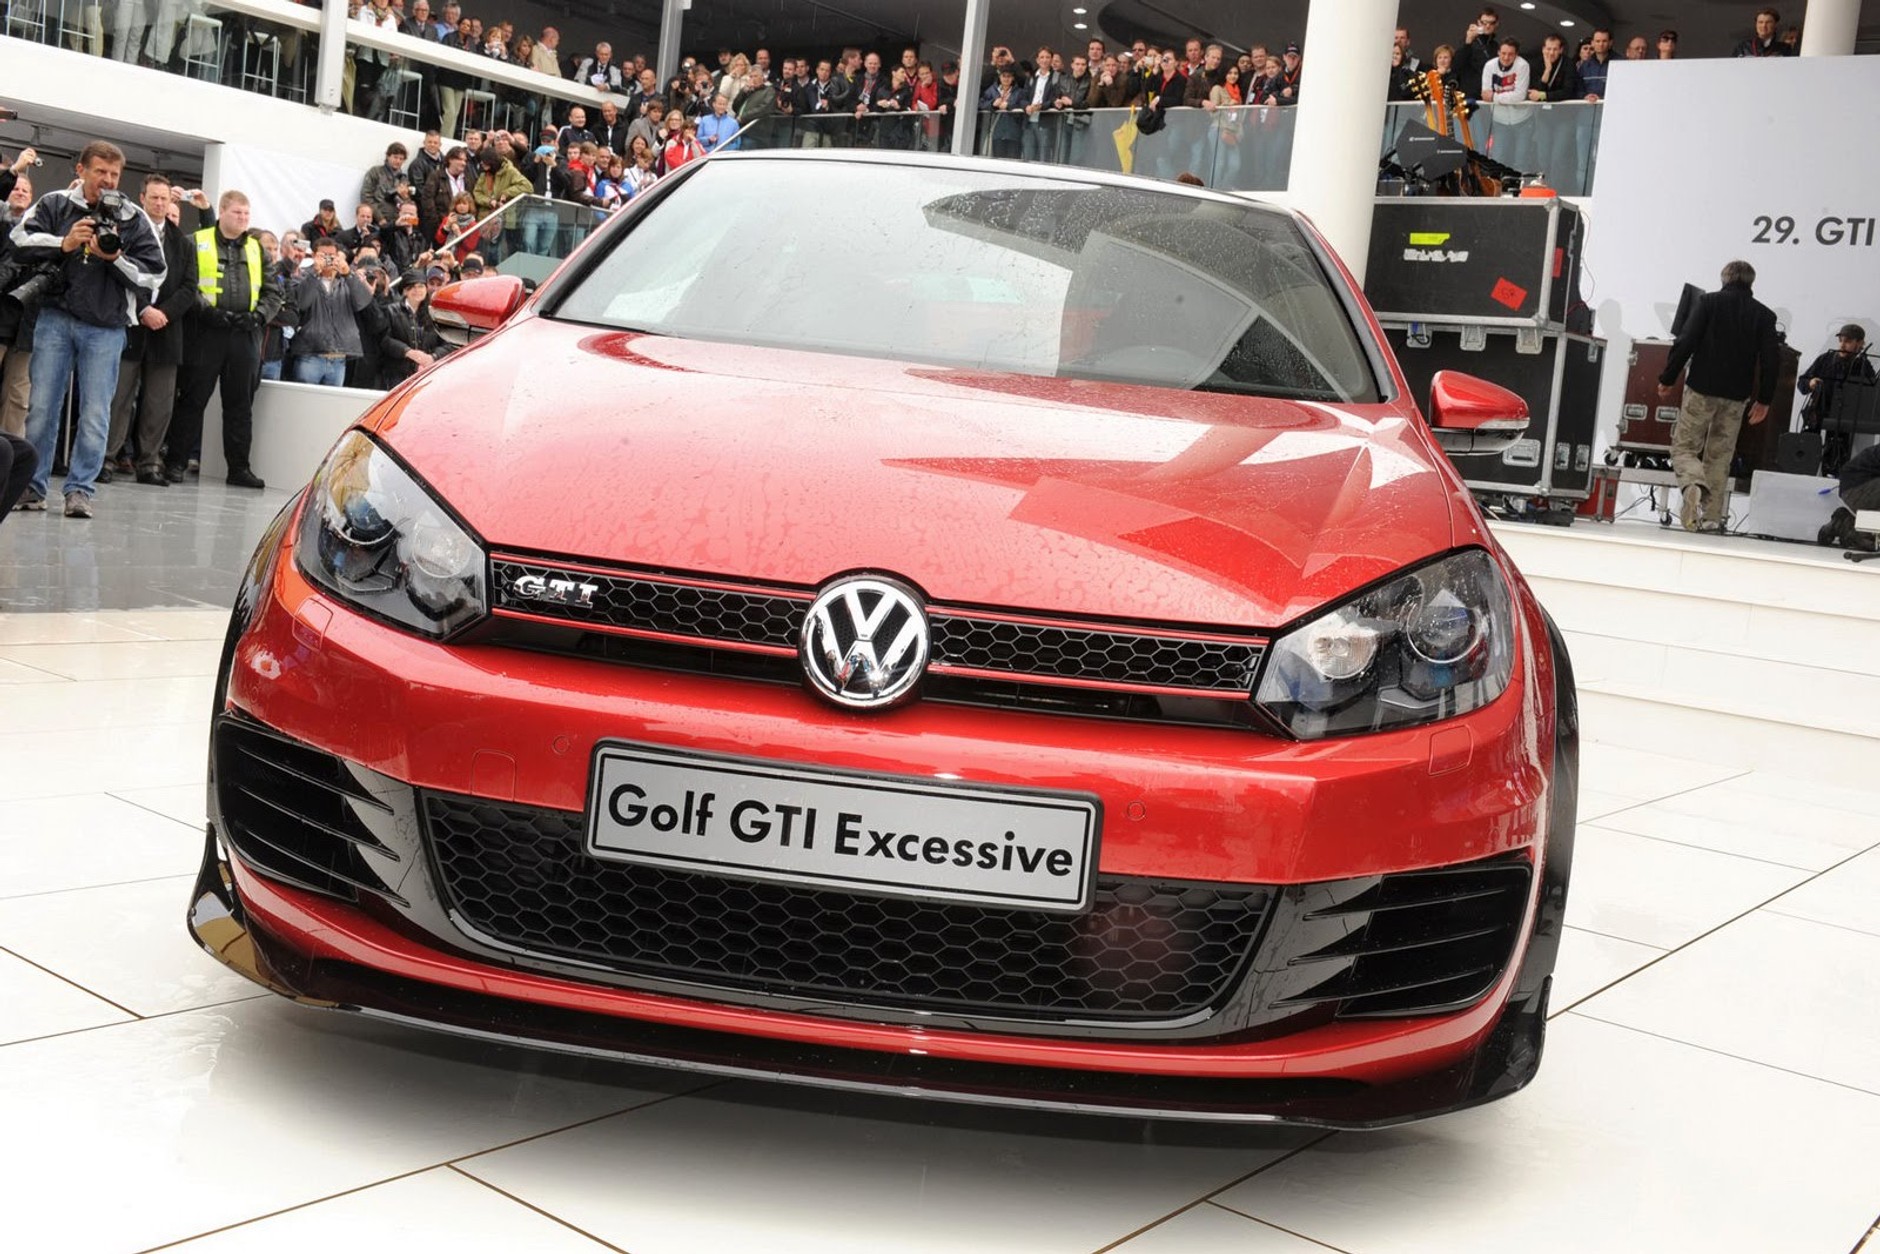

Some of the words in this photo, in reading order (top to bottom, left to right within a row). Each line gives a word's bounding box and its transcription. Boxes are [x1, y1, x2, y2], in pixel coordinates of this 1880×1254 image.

[1752, 215, 1800, 245] 29.
[1815, 216, 1876, 246] GTI
[513, 575, 599, 609] GTI
[810, 583, 922, 702] VW
[608, 784, 715, 836] Golf
[730, 800, 816, 850] GTI
[834, 812, 1073, 877] Excessive
